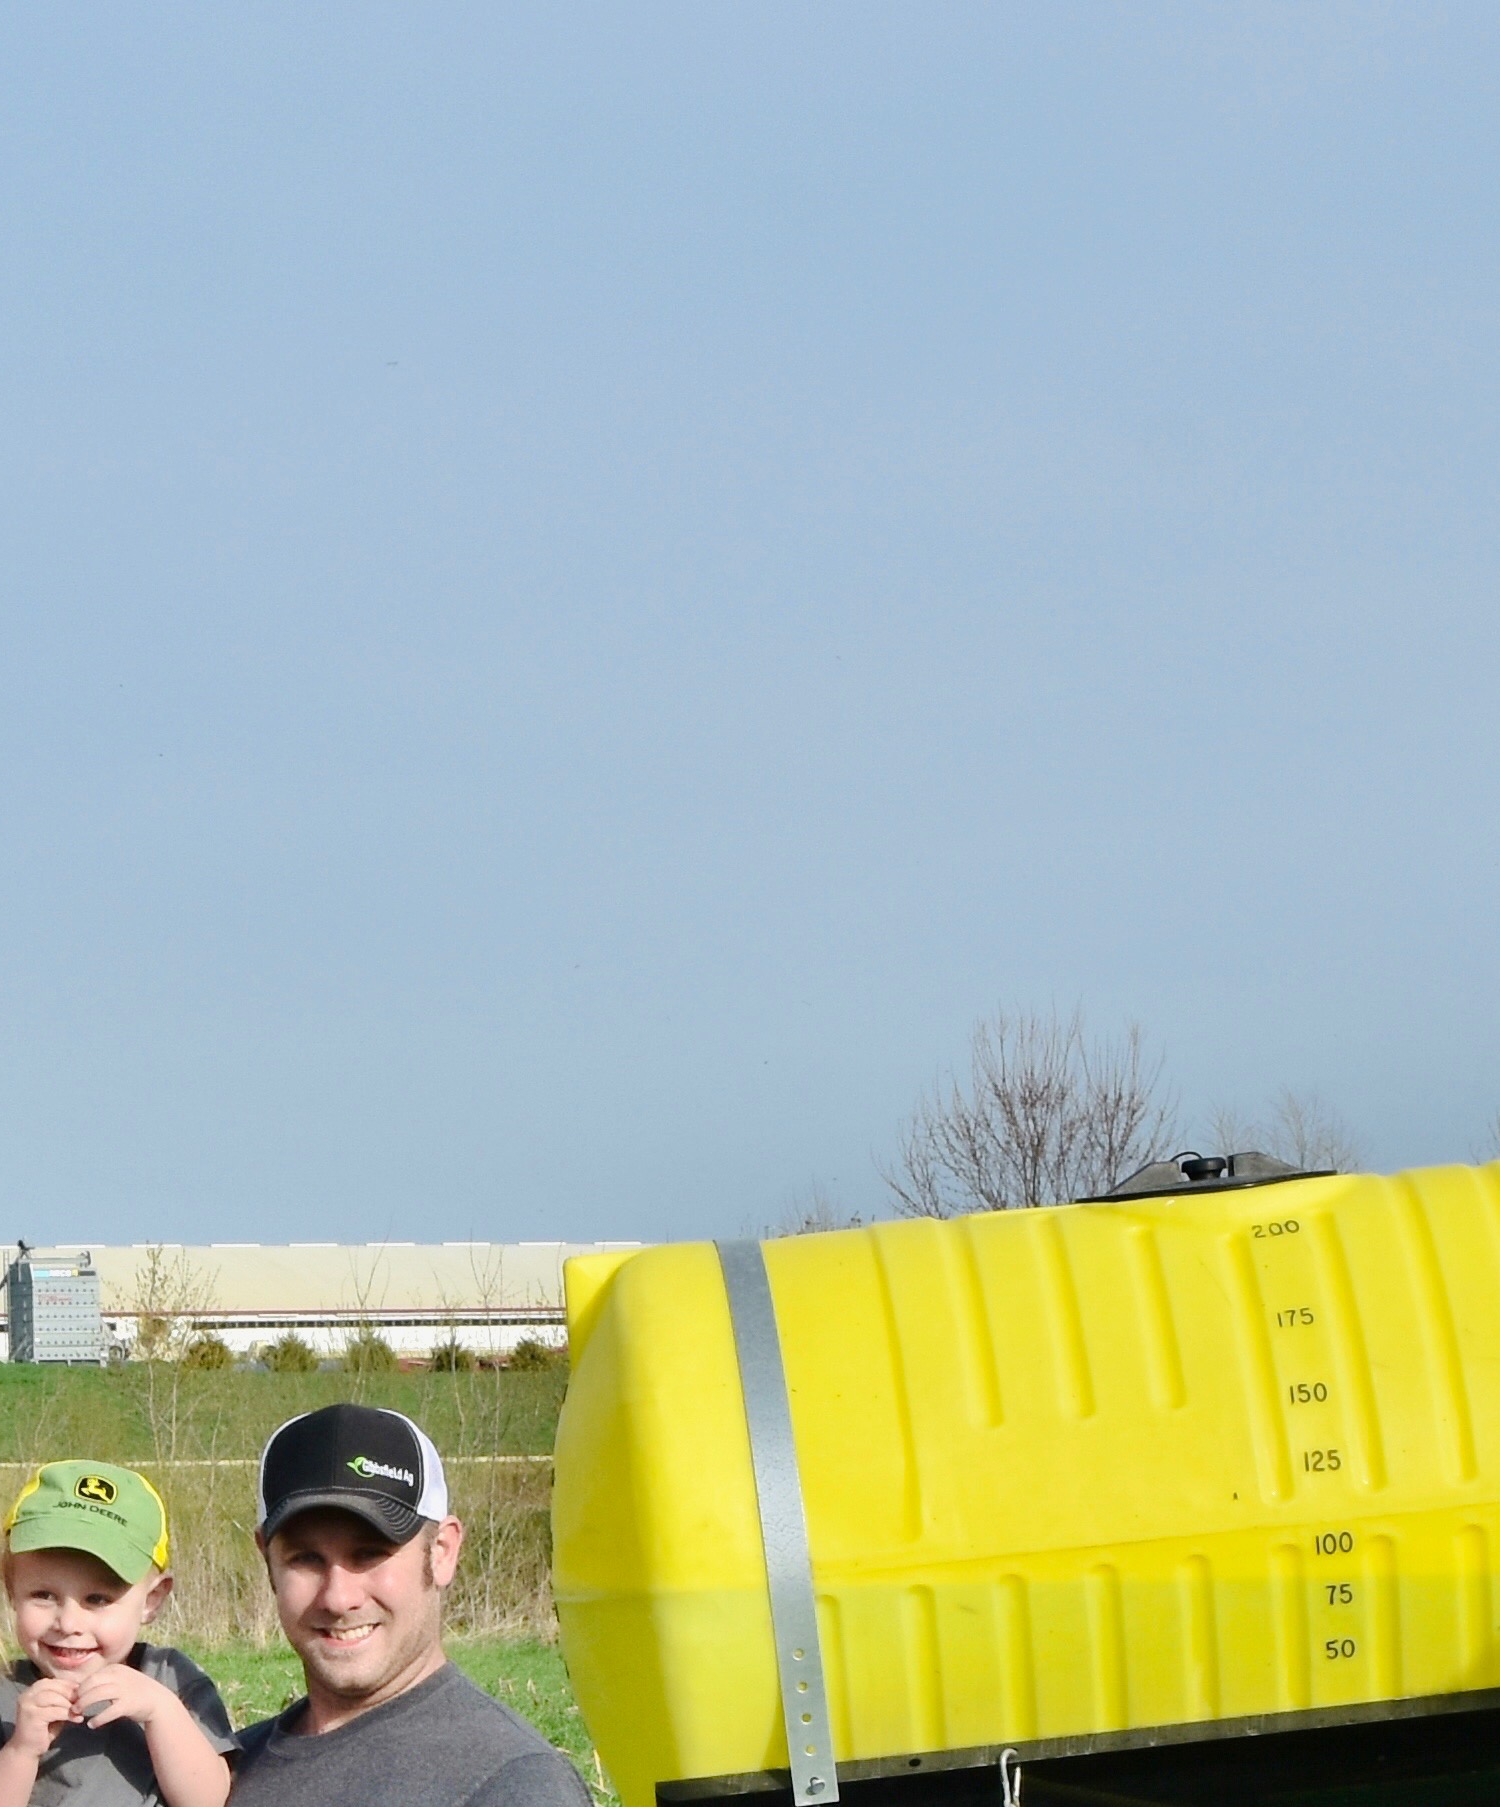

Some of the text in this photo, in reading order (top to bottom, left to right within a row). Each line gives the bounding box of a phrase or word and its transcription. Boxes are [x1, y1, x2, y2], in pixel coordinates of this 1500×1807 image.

[1251, 1219, 1300, 1239] 200
[1276, 1307, 1315, 1328] 175
[1289, 1382, 1328, 1405] 150
[1304, 1449, 1342, 1472] 125
[52, 1501, 128, 1528] JOHN DEERE
[1315, 1531, 1354, 1555] 100
[1325, 1583, 1354, 1605] 75
[1325, 1639, 1356, 1660] 50
